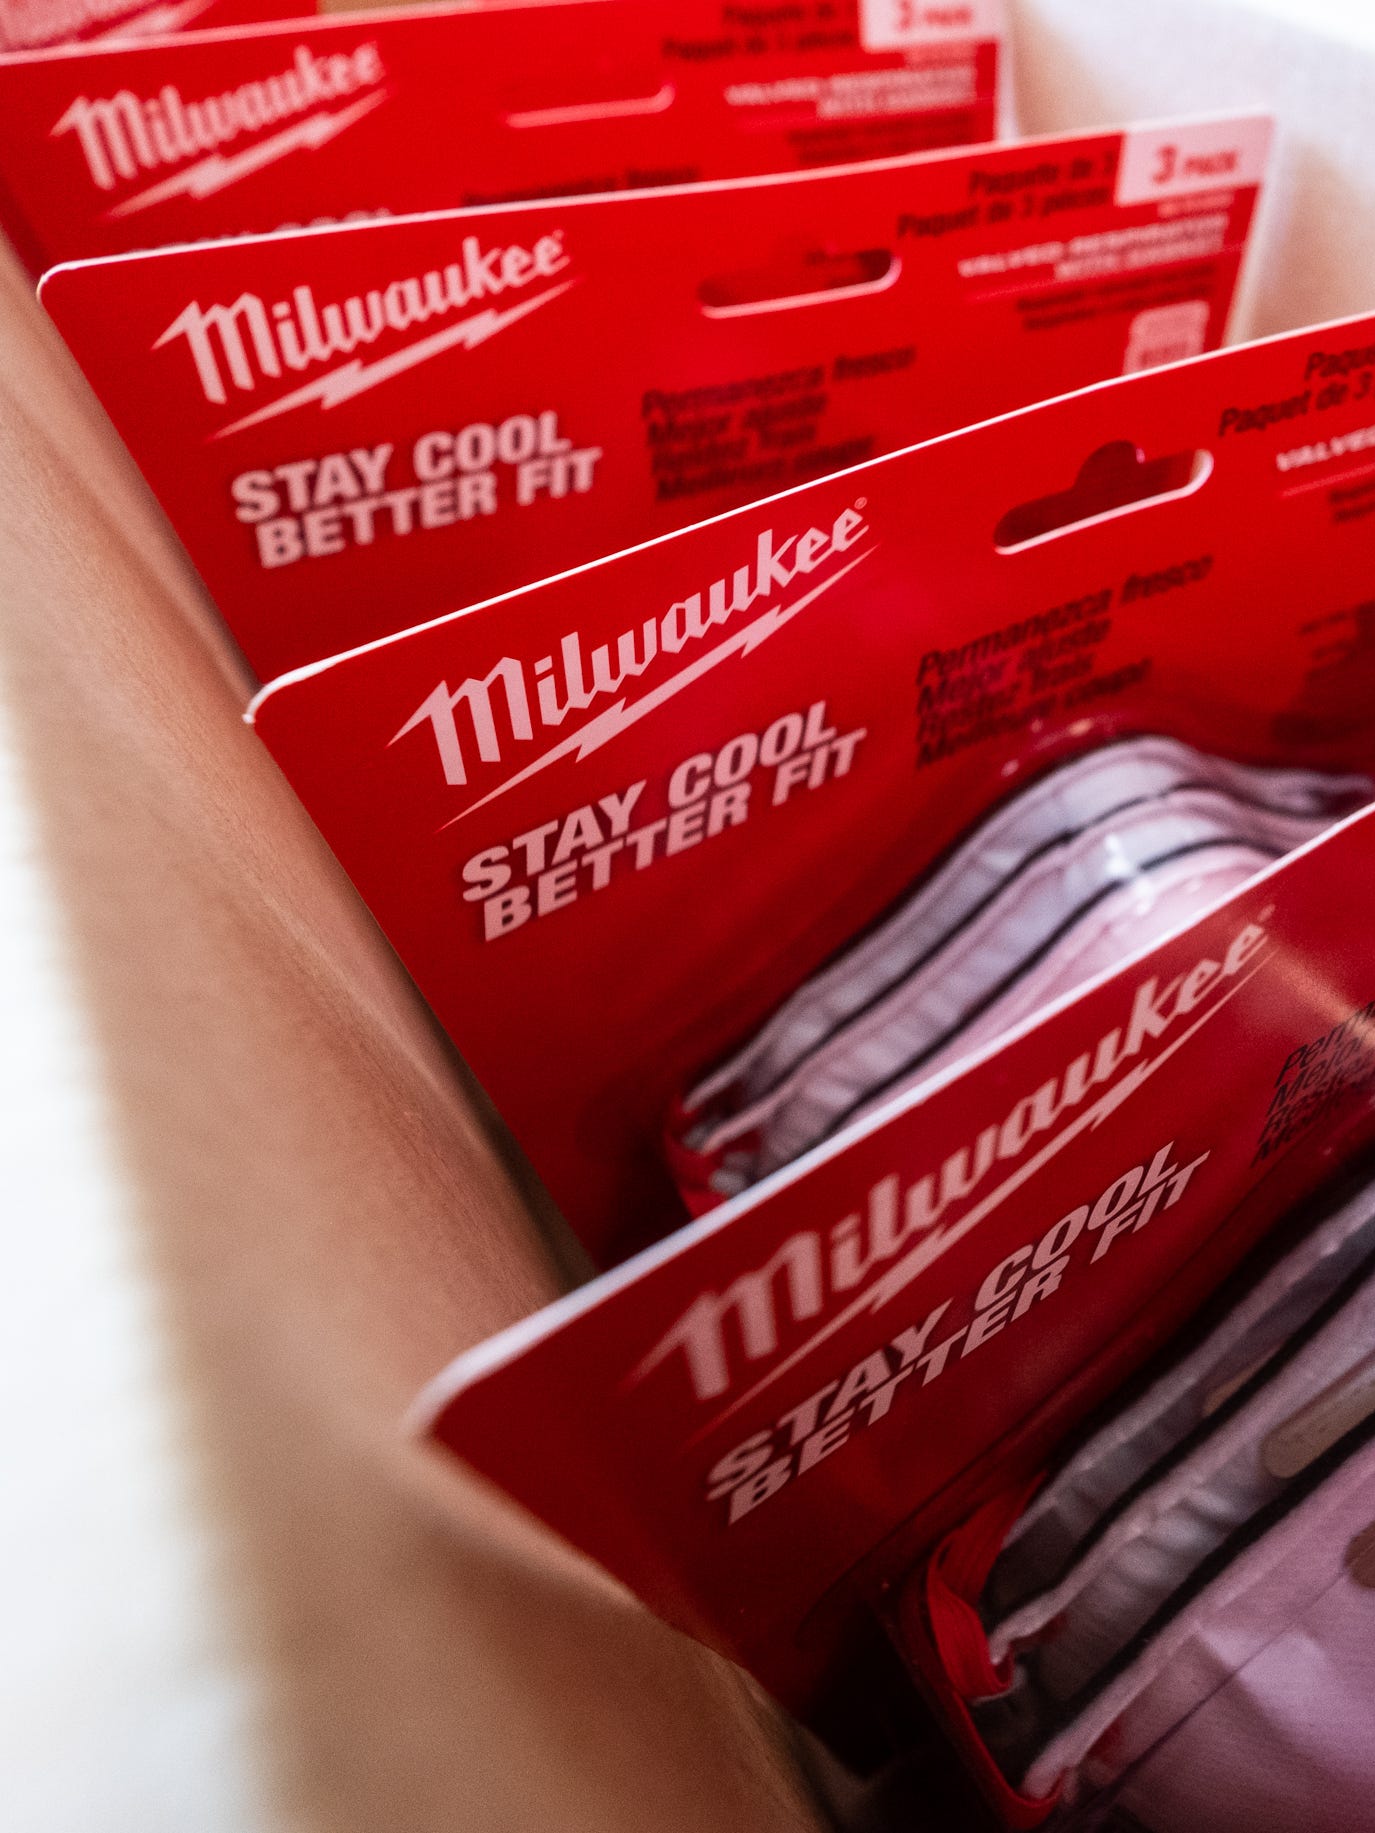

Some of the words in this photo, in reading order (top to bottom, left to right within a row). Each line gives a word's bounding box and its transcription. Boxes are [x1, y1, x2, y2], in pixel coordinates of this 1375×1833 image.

[49, 41, 386, 191] Milwaukee
[151, 235, 571, 404] Milwaukee
[231, 443, 394, 523] STAY
[413, 410, 572, 482] COOL
[255, 471, 497, 569] BETTER
[516, 446, 603, 506] FIT
[386, 508, 869, 785] Milwaukee
[462, 779, 647, 901] STAY
[668, 700, 837, 809] COOL
[484, 782, 752, 941] BETTER
[772, 728, 867, 806] FIT
[624, 923, 1269, 1399] Milwaukee
[707, 1298, 955, 1500] STAY
[973, 1140, 1177, 1312] COOL
[728, 1257, 1065, 1527] BETTER
[1090, 1149, 1211, 1264] FIT
